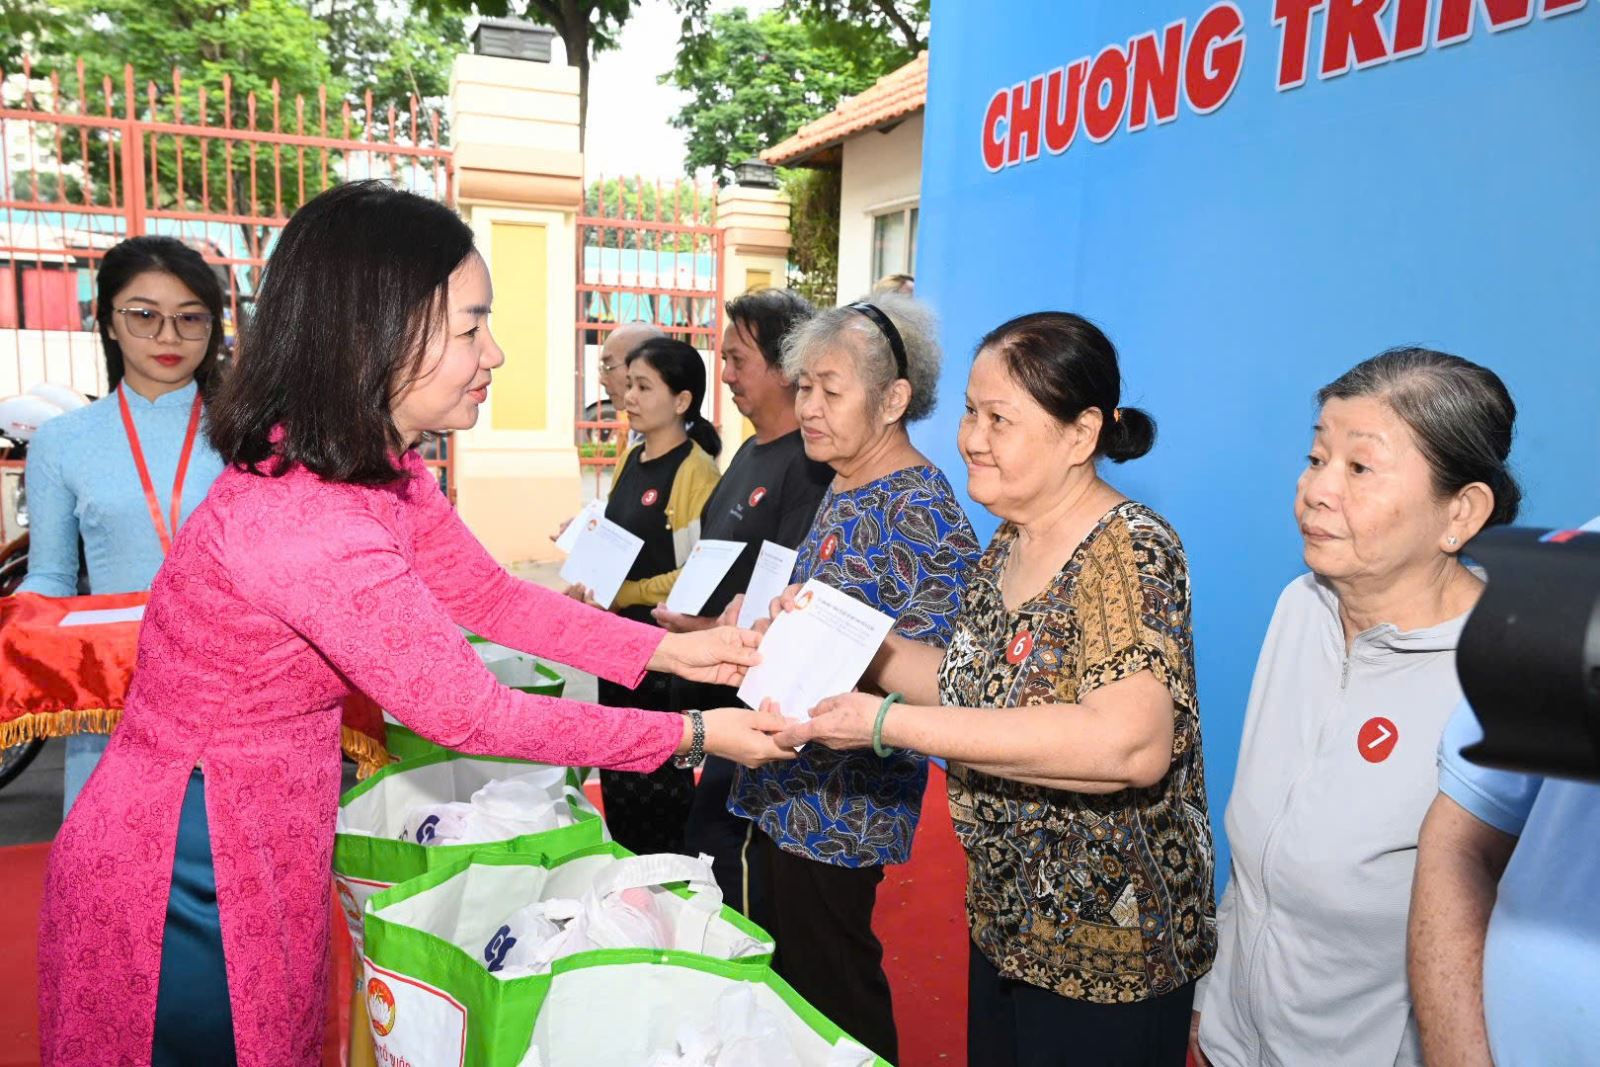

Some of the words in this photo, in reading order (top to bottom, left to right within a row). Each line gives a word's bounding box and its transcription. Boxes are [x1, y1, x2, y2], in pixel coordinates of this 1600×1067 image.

[982, 3, 1245, 171] CHƯƠNG
[1013, 636, 1026, 656] 6
[1367, 724, 1392, 749] 7
